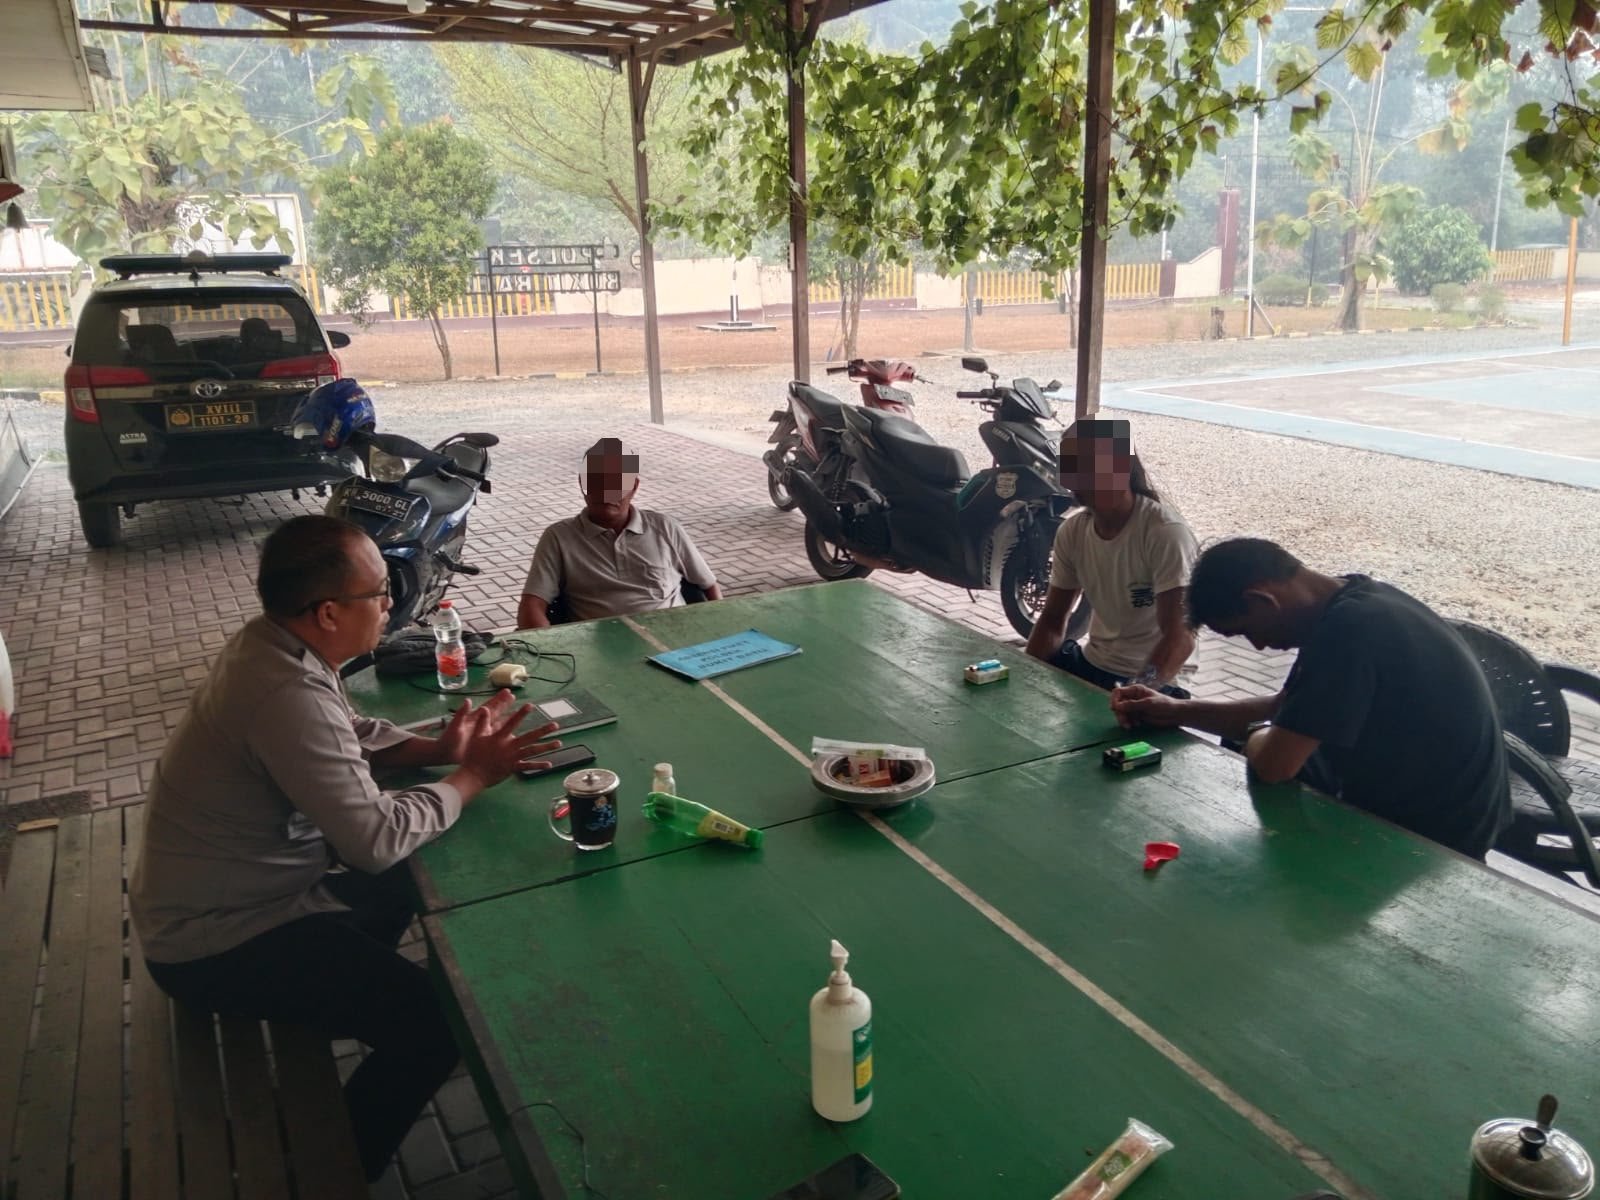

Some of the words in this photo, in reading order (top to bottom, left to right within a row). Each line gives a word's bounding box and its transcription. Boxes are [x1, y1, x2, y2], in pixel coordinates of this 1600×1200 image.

[206, 403, 240, 415] XVIII
[362, 490, 391, 504] 5000
[394, 499, 408, 511] GL
